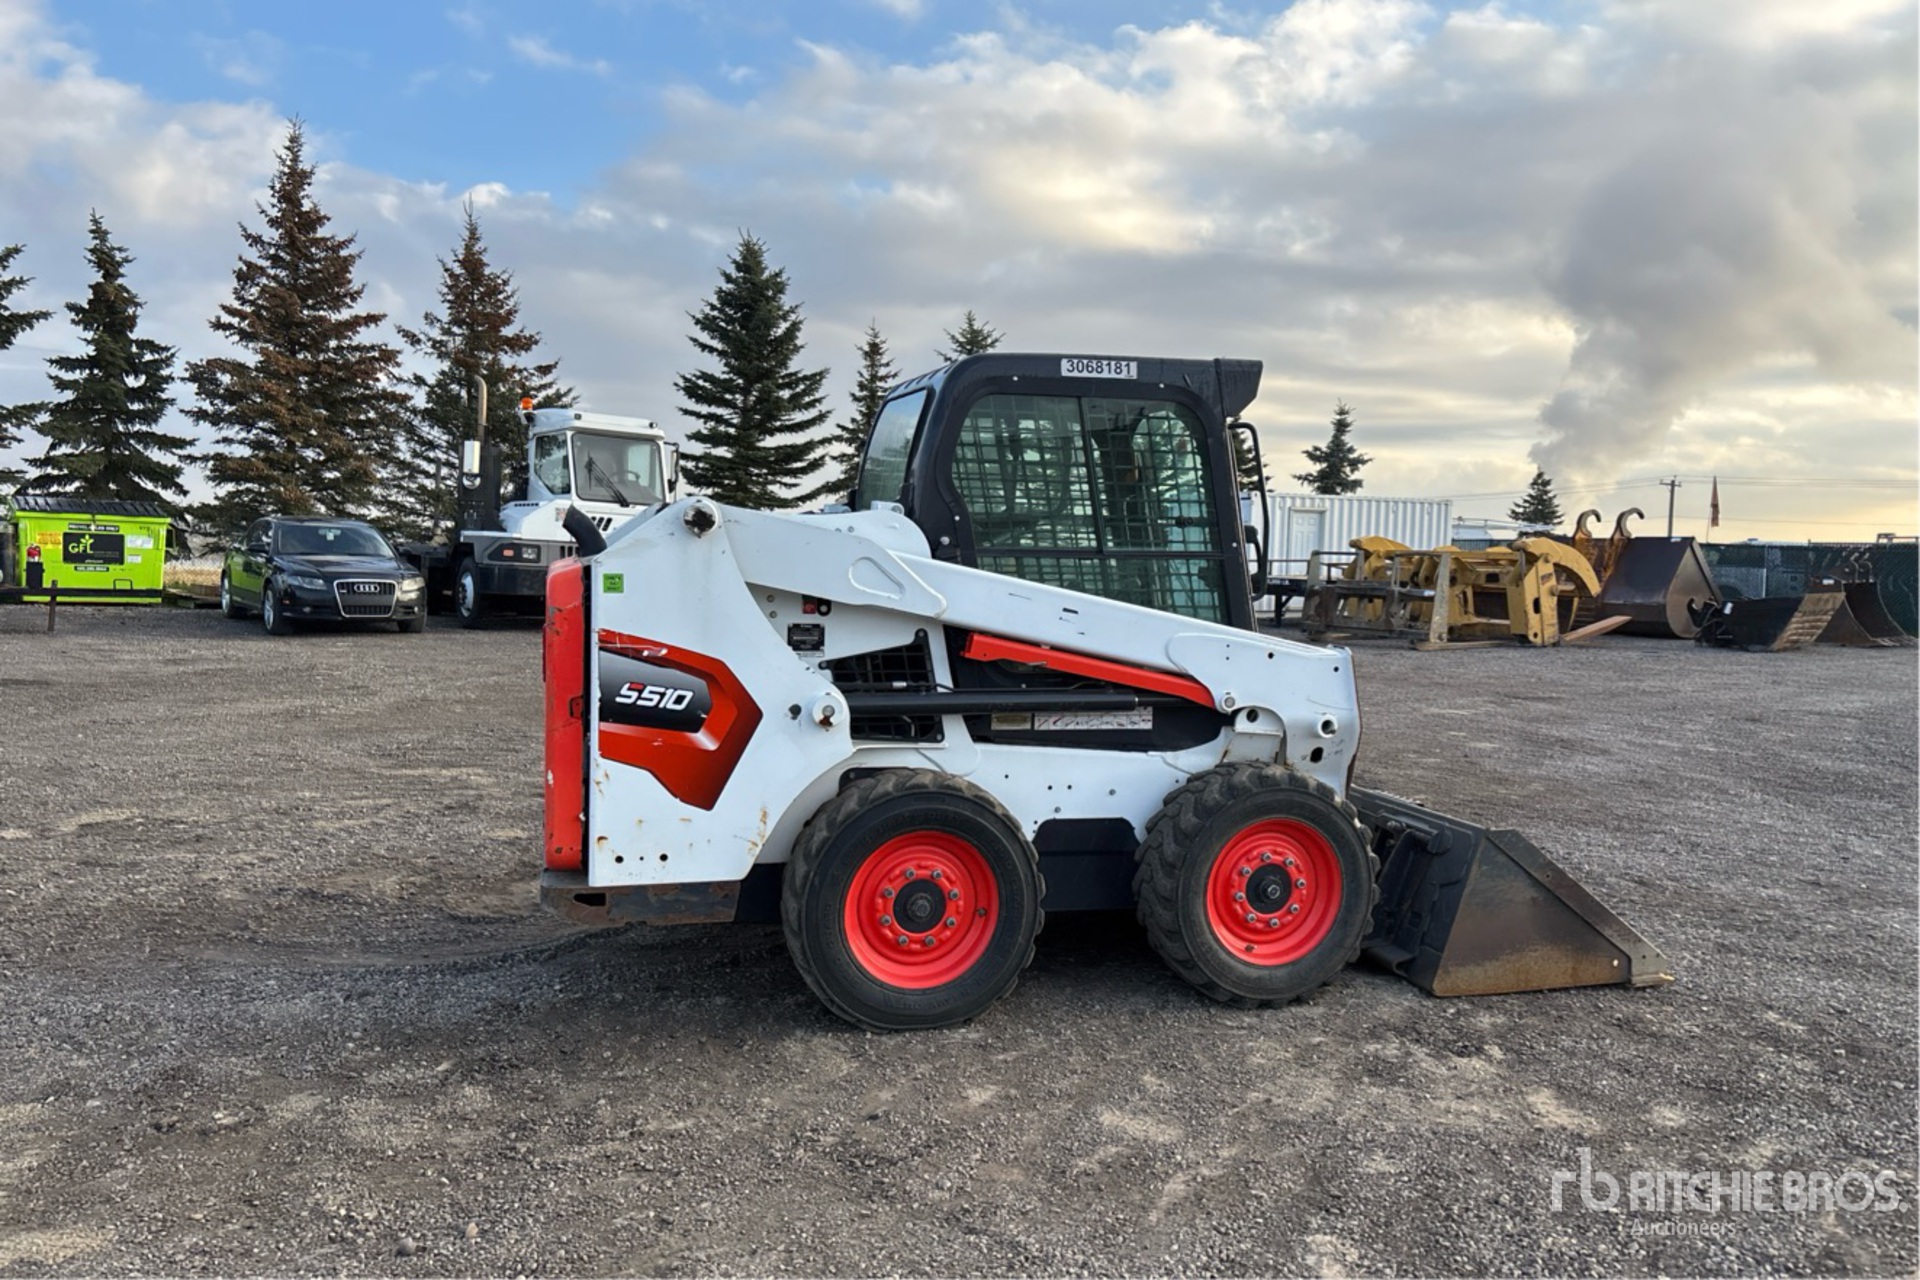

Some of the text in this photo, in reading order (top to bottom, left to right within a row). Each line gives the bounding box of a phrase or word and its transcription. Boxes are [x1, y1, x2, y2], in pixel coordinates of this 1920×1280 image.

[1066, 359, 1132, 376] 3068181
[68, 538, 94, 554] GFL
[615, 682, 694, 711] S510
